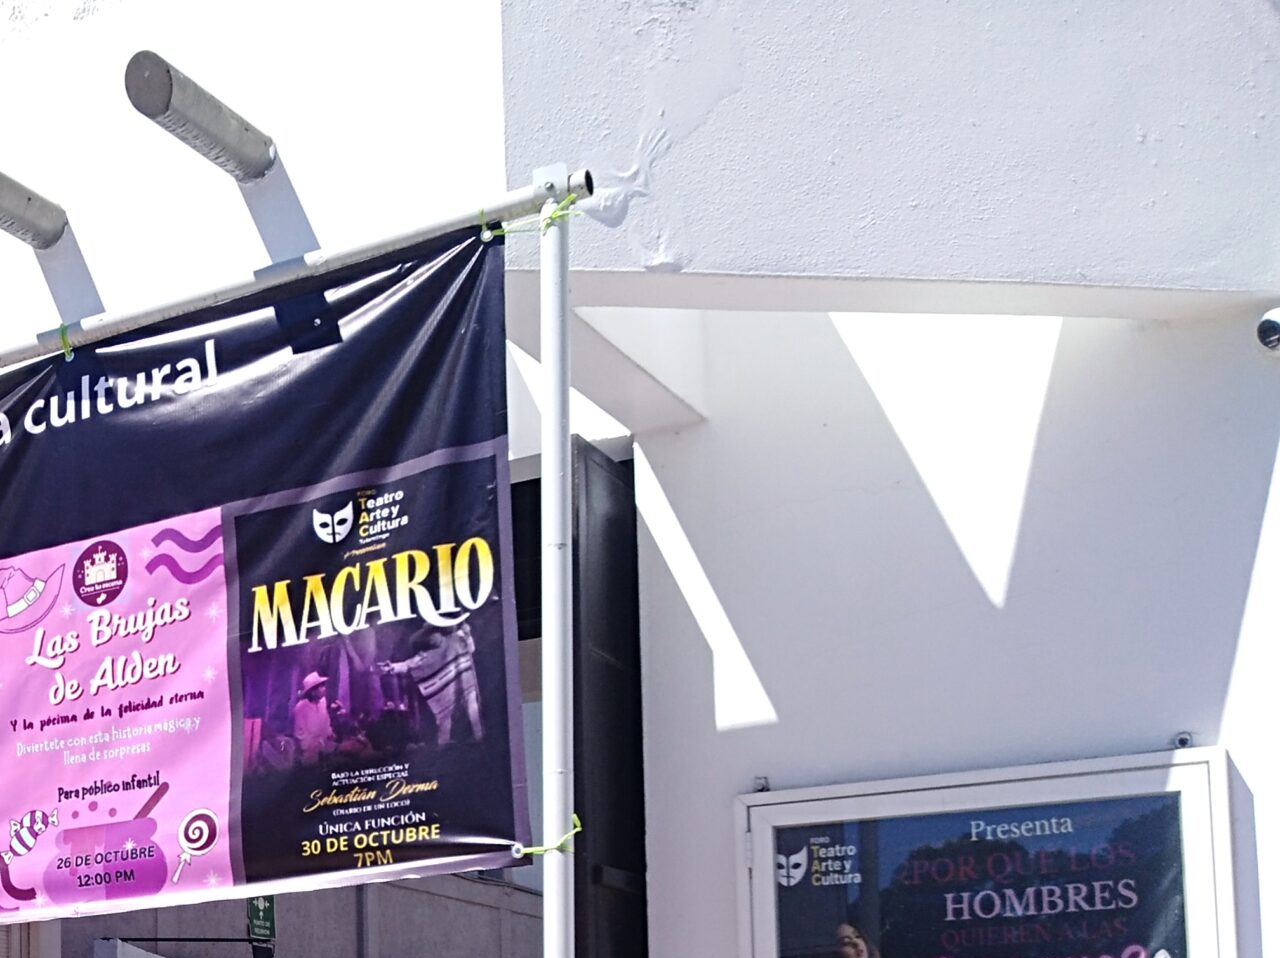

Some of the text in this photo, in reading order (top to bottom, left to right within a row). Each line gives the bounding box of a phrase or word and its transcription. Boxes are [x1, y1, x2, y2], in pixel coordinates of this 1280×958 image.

[24, 339, 219, 435] cultural
[358, 489, 404, 511] Teatro
[358, 514, 409, 538] Cultura
[359, 504, 400, 524] Arte y
[248, 537, 494, 653] MACARIO
[25, 597, 192, 670] Las Brujas
[48, 650, 181, 705] de Alden
[10, 719, 18, 732] Y
[23, 718, 34, 730] la
[83, 708, 95, 721] de
[101, 705, 112, 718] la
[118, 696, 163, 718] felicidad
[169, 690, 205, 705] eterna
[67, 735, 87, 747] con
[89, 731, 110, 746] esta
[112, 724, 153, 741] historia
[63, 750, 87, 765] llena
[89, 748, 101, 761] de
[350, 769, 360, 777] LA
[58, 785, 80, 802] Para
[122, 771, 160, 790] infantil
[303, 785, 377, 813] Sebastián
[319, 811, 426, 836] ÚNICA FUNCIÓN
[969, 817, 1074, 843] Presenta
[301, 823, 441, 857] 30 DE OCTUBRE
[810, 845, 857, 858] Teatro
[57, 846, 155, 870] 26 DE OCTUBRE
[354, 849, 393, 868] 7PM
[811, 859, 852, 873] Arte y
[1070, 842, 1137, 872] LOS
[77, 869, 135, 888] 12:00 PM
[811, 872, 862, 886] Cultura
[944, 879, 1138, 922] HOMBRES
